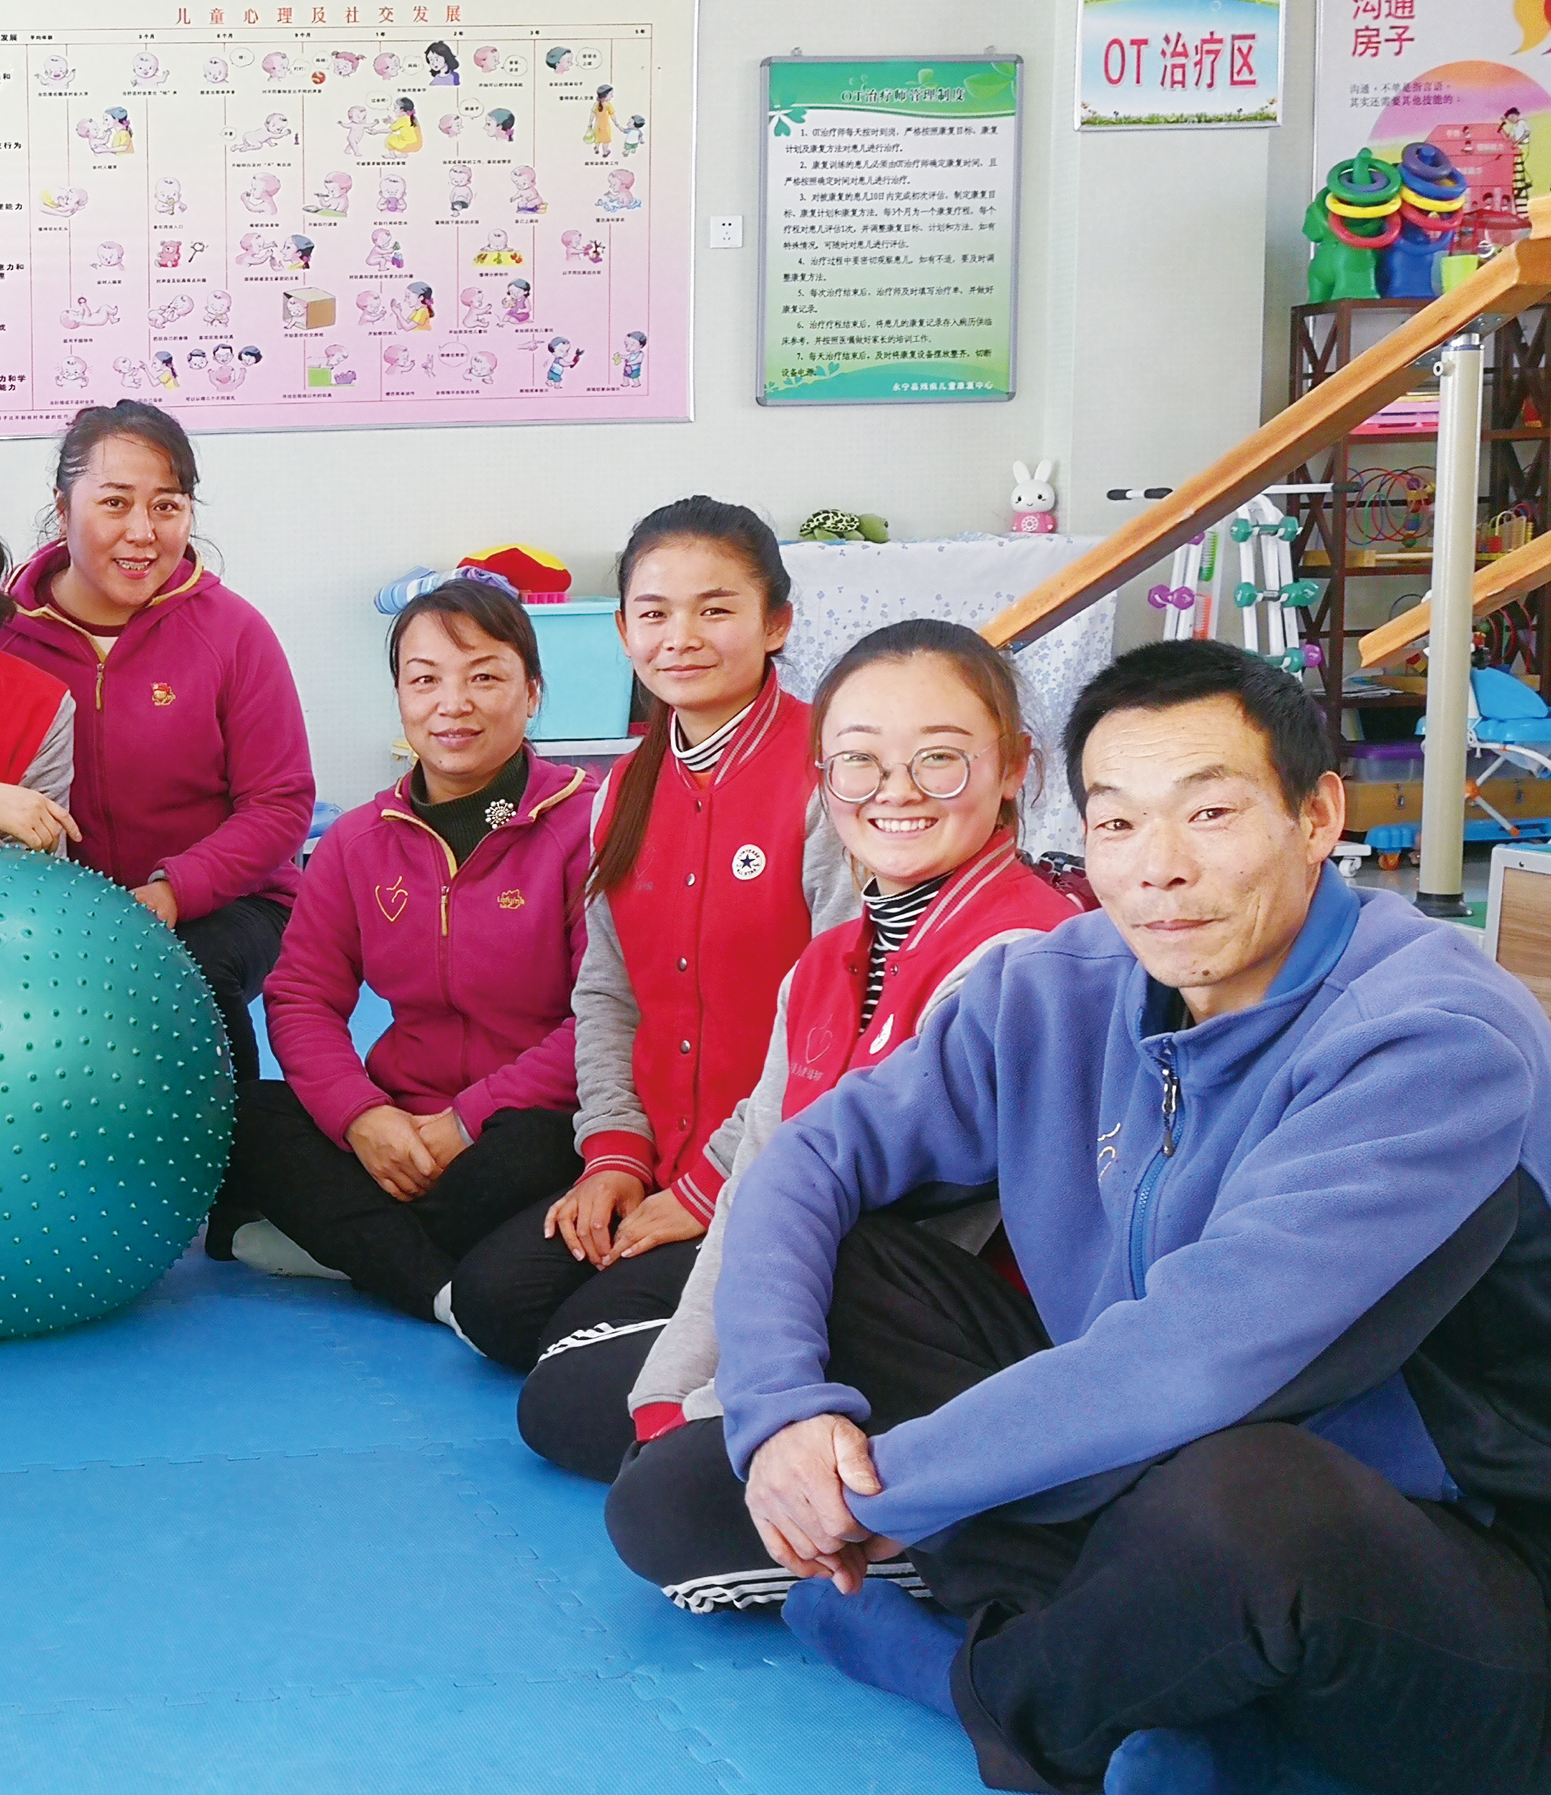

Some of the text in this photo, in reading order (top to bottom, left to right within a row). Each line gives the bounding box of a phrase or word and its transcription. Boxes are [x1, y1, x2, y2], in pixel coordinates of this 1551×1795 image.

[175, 5, 461, 25] 儿童心理及社交发展
[1353, 0, 1416, 21] 沟通
[1351, 25, 1415, 58] 房子
[1103, 31, 1257, 89] OT 治疗区
[841, 87, 966, 102] OT治疗师管理制度
[785, 143, 903, 154] 计划及康复方法对患儿进行治疗。
[784, 175, 911, 187] 严格按照确定时间对患儿进行治疗。
[783, 273, 827, 282] 整康复方法。
[782, 304, 818, 314] 康复记录。
